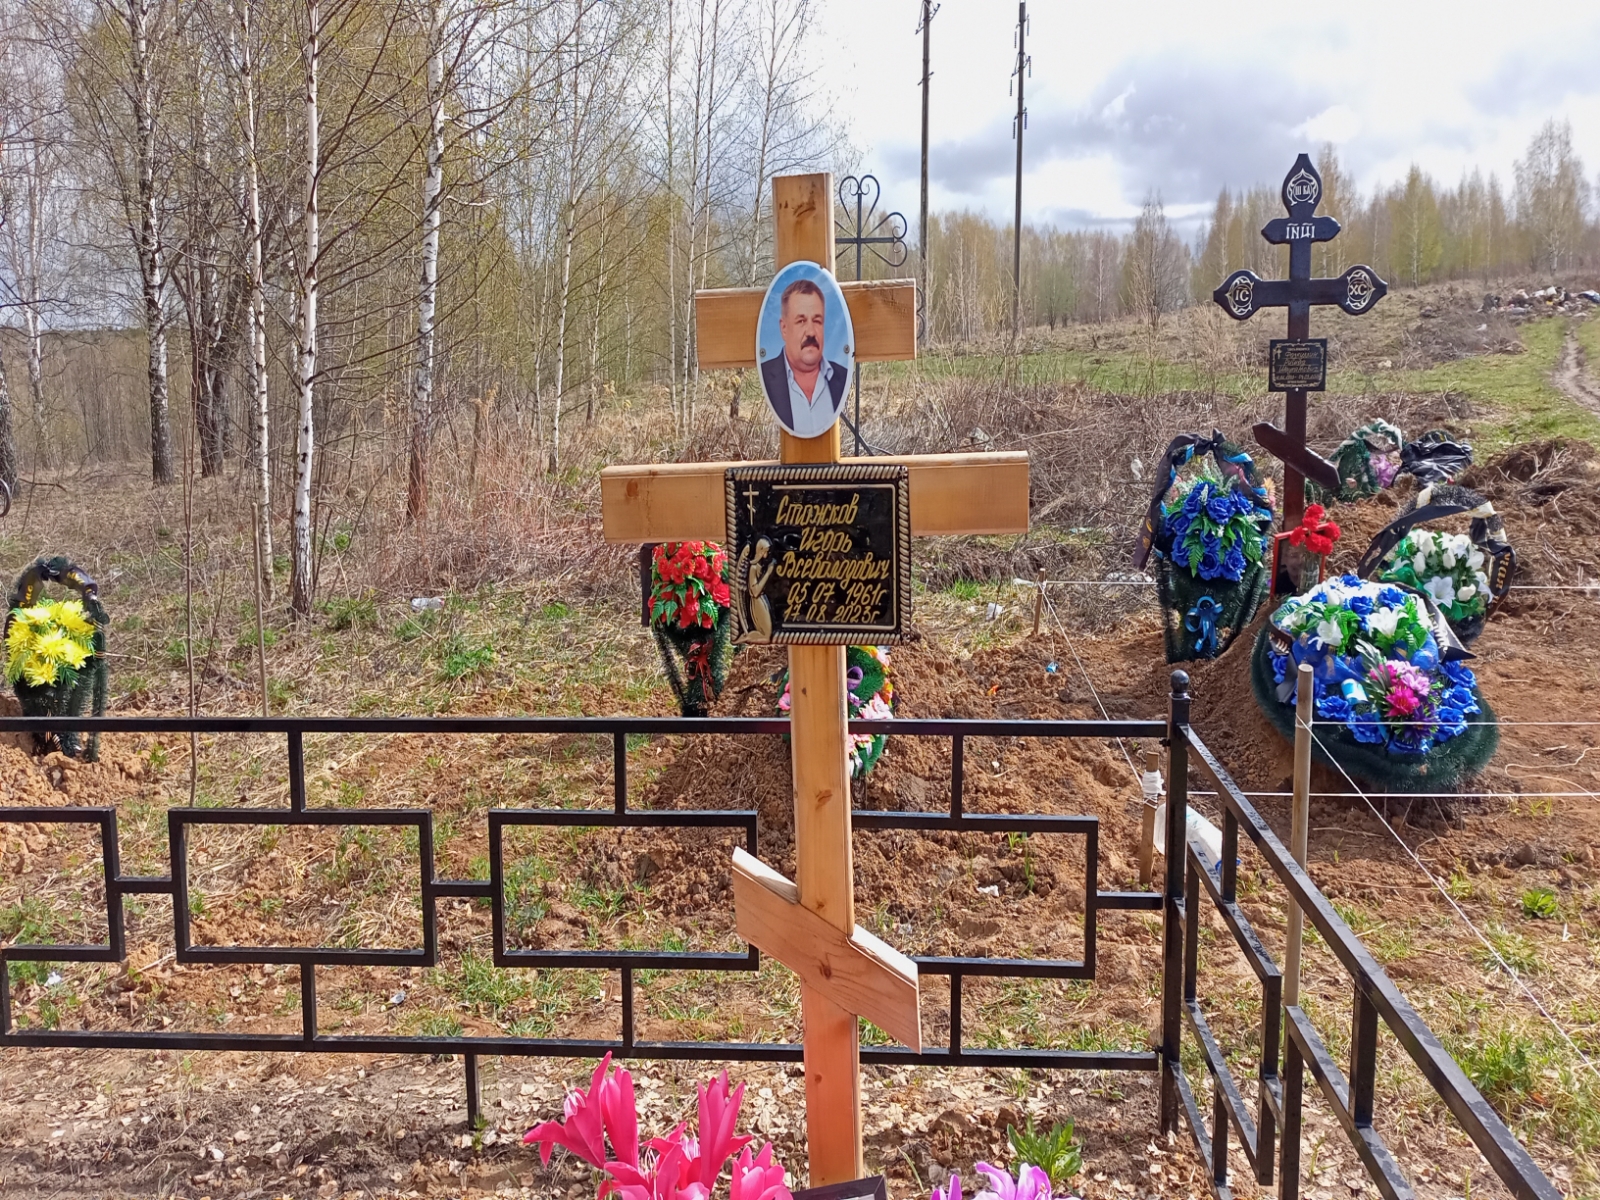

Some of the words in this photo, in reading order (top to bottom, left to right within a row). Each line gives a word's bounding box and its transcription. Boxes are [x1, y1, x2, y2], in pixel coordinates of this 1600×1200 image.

[775, 492, 860, 526] Стожков
[799, 526, 853, 560] Игорь
[775, 551, 890, 590] Всеволодович
